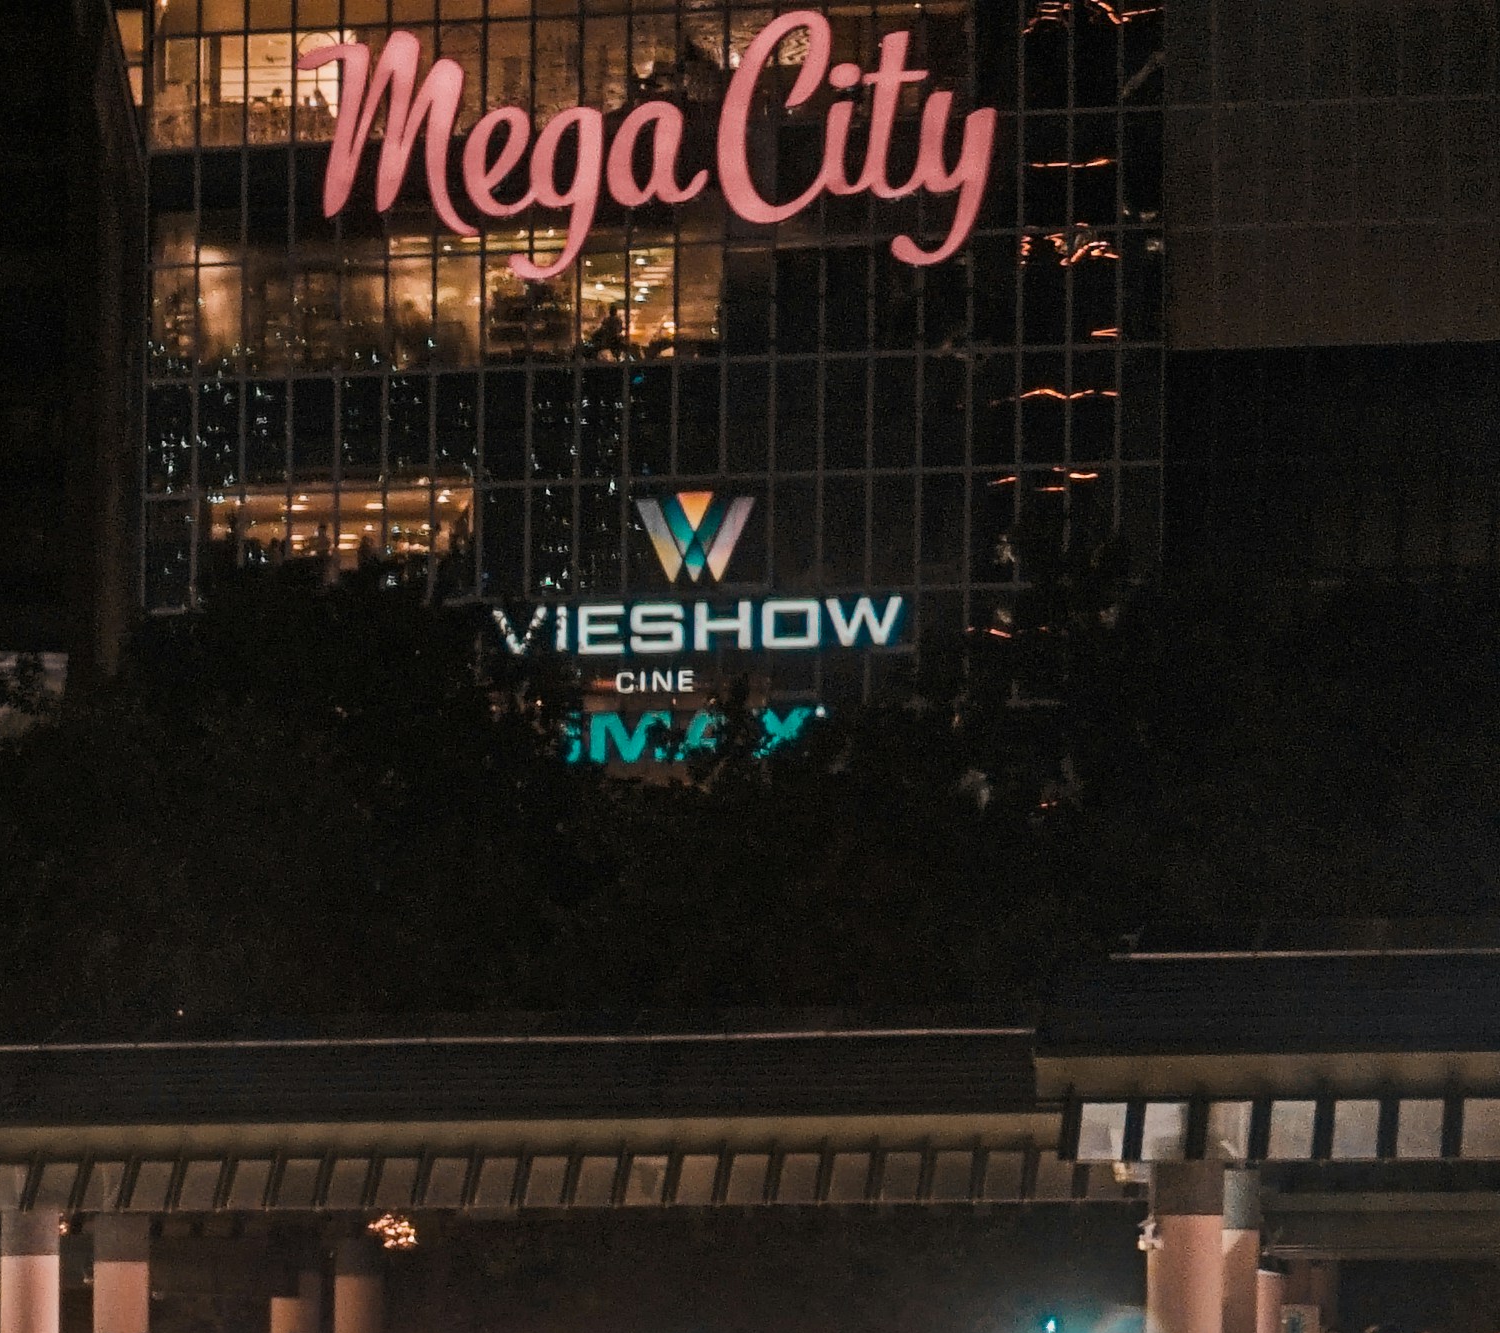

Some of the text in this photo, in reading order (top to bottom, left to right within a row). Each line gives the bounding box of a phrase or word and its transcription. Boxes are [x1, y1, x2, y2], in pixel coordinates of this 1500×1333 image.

[299, 10, 997, 279] Mega City
[492, 596, 902, 655] VIESHOW
